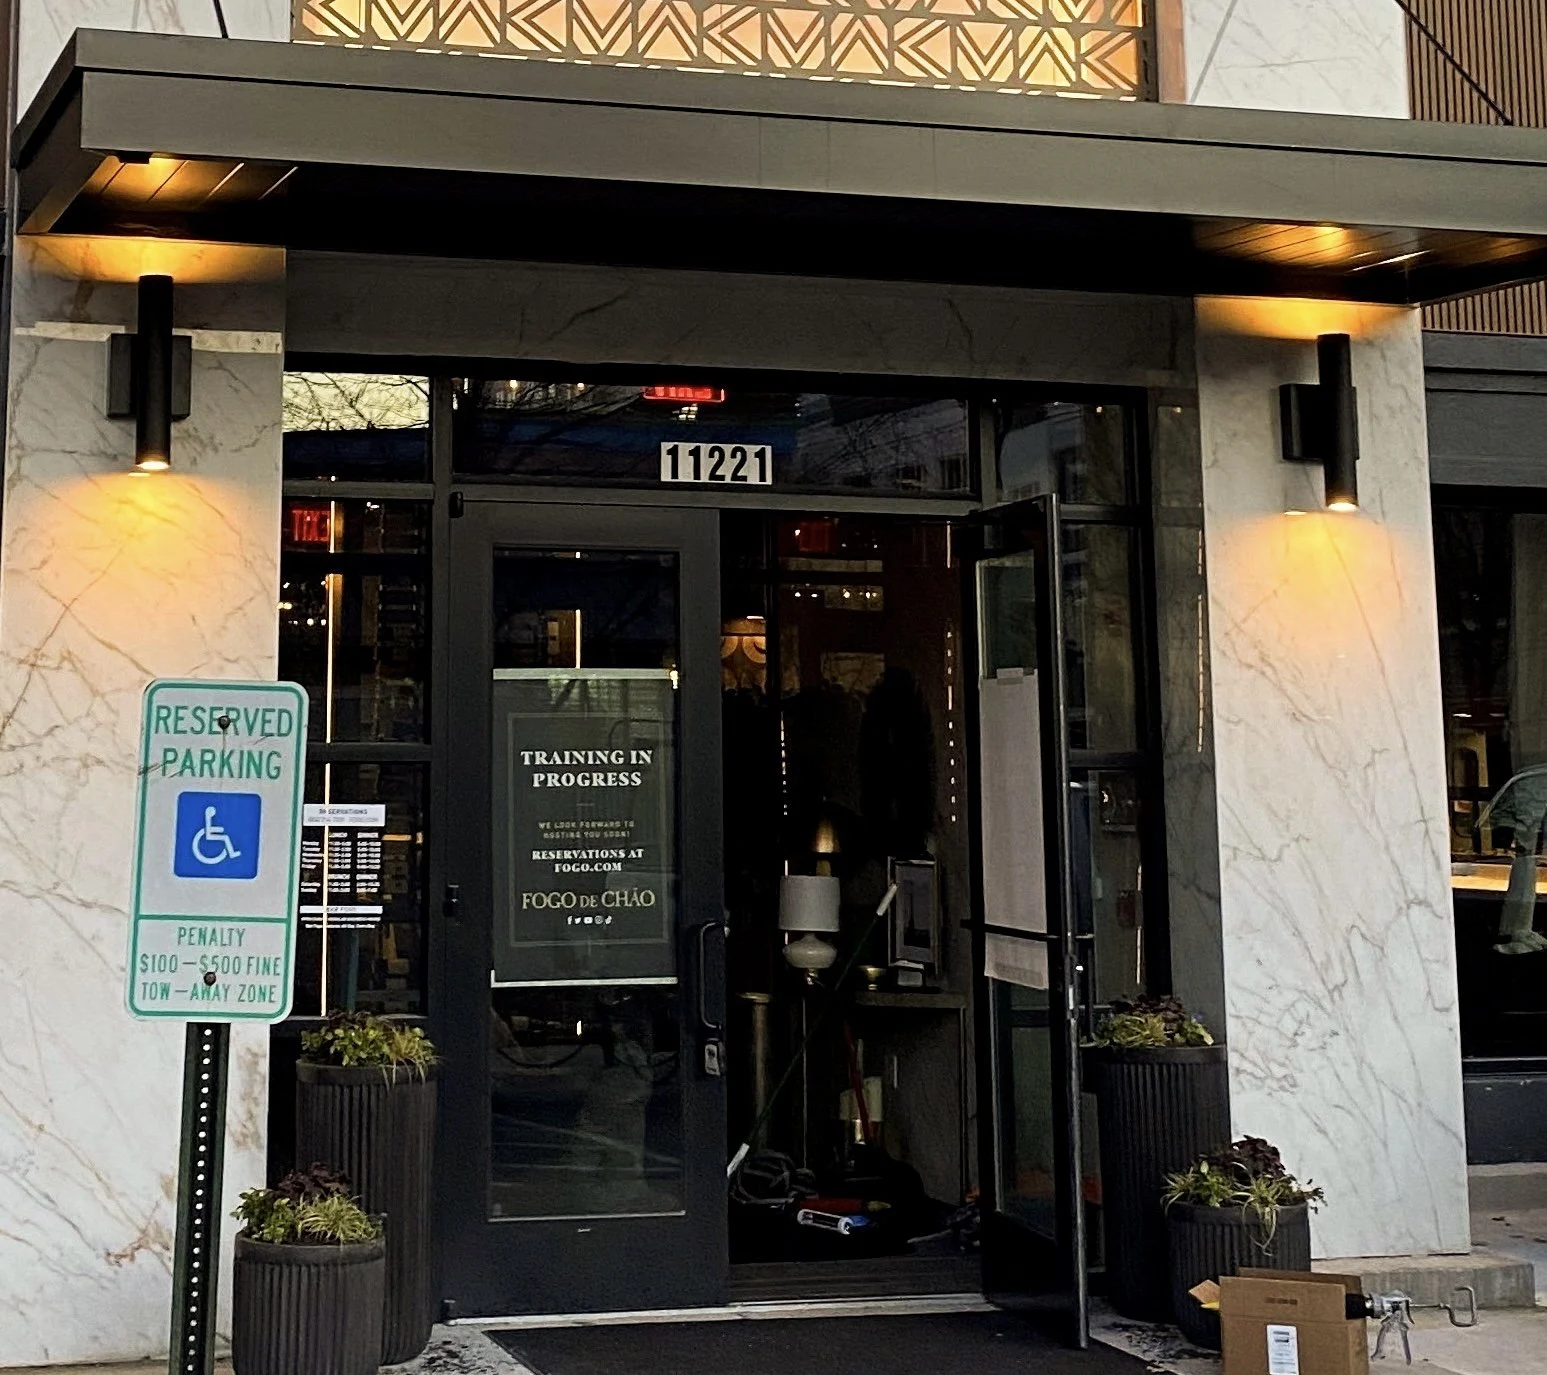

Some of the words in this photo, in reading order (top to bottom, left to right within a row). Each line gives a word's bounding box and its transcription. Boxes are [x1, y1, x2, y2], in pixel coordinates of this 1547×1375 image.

[666, 444, 767, 482] 11221
[155, 705, 292, 737] RESERVED
[161, 747, 282, 780] PARKING
[520, 750, 625, 765] TRAINING
[630, 749, 653, 764] IN
[532, 771, 642, 787] PROGRESS
[532, 849, 626, 860] RESERVATIONS
[628, 848, 644, 858] AT
[554, 862, 622, 873] FOGO.COM
[522, 891, 577, 910] FOGO
[580, 894, 598, 908] DE
[601, 887, 656, 908] CHÃO
[177, 926, 246, 947] PENALTY
[246, 956, 281, 976] FINE
[237, 984, 277, 1003] ZONE
